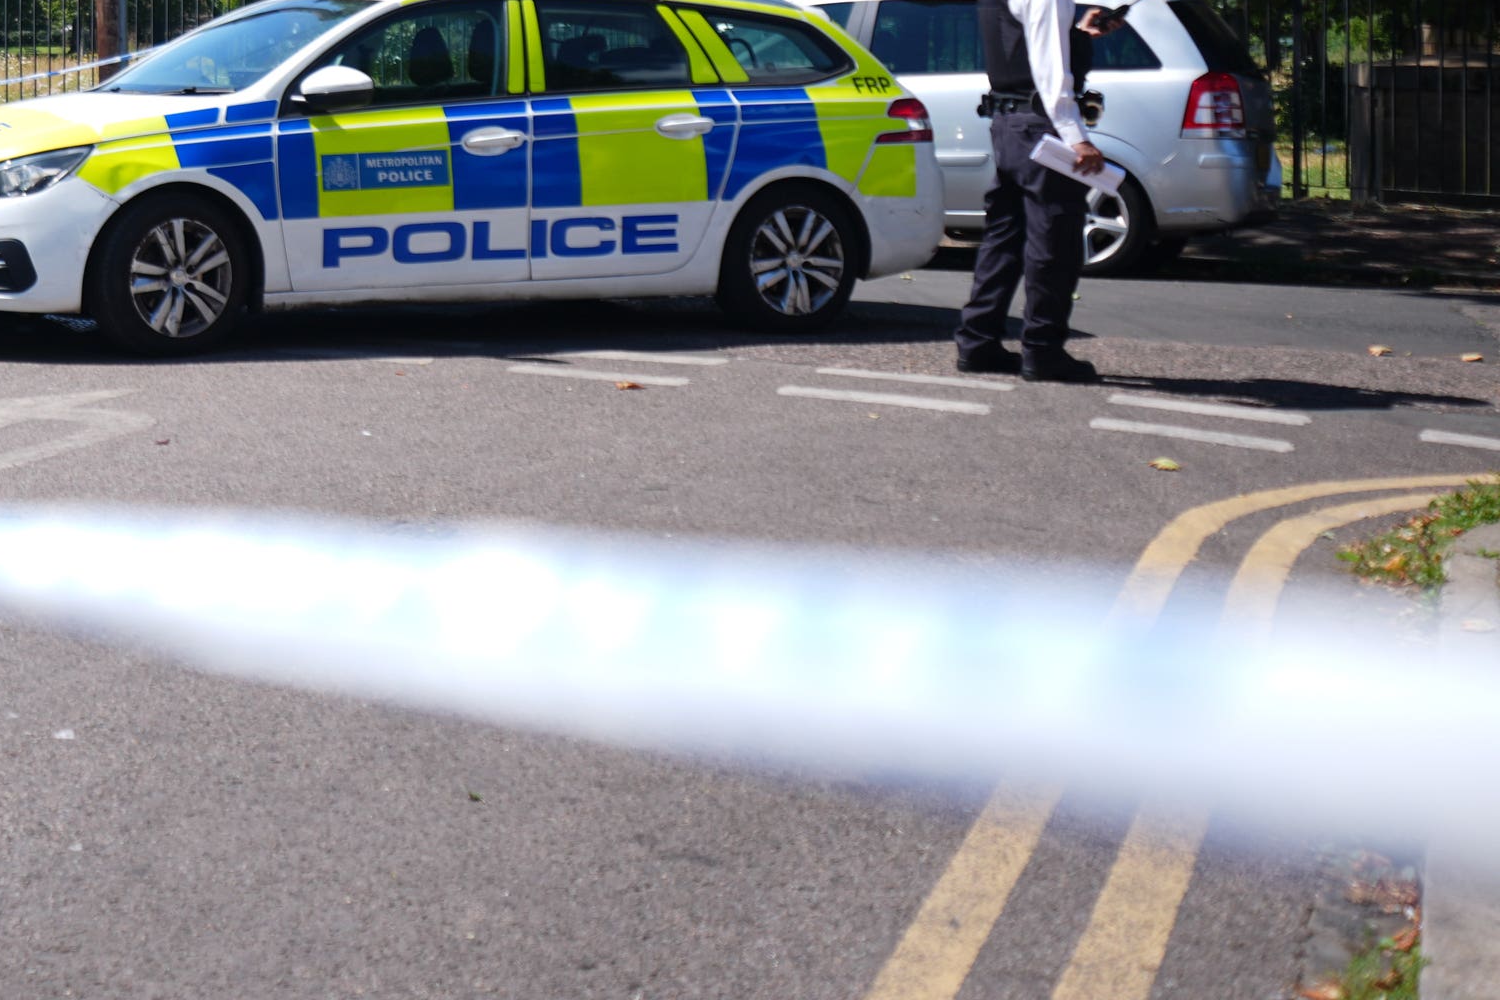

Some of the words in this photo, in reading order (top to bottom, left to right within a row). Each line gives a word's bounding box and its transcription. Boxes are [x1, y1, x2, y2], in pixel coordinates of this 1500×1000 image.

[852, 76, 891, 94] FRP
[366, 155, 443, 169] METROPOLITAN
[378, 170, 434, 183] POLICE
[322, 214, 679, 268] POLICE
